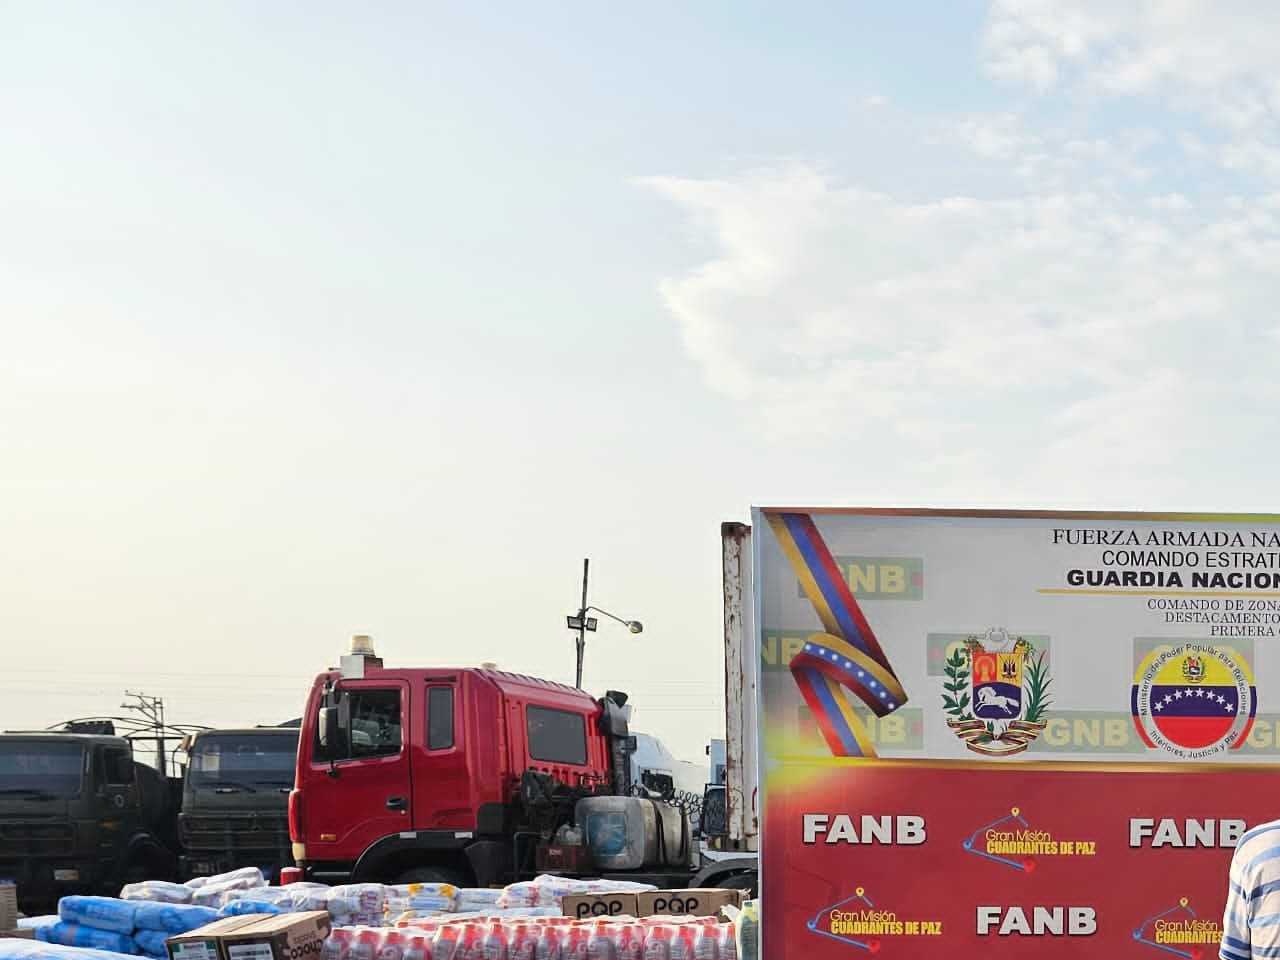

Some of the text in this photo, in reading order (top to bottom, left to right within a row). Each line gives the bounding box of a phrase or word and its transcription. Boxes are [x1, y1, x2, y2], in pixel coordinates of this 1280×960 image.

[1052, 529, 1142, 546] FUERZA
[1147, 531, 1245, 547] ARMADA
[1102, 550, 1199, 567] COMANDO
[838, 564, 905, 593] NB
[1067, 569, 1183, 588] GUARDIA
[1147, 599, 1220, 611] COMANDO
[1225, 599, 1244, 611] DE
[1165, 612, 1280, 624] DESTACAMENTO
[1211, 625, 1274, 637] PRIMERA
[761, 636, 804, 665] NB
[1160, 645, 1184, 663] Poder
[1186, 643, 1218, 656] Popular
[1043, 718, 1129, 747] GNB
[802, 814, 927, 845] FANB
[985, 829, 1051, 842] Gran Misión
[1129, 818, 1247, 849] FANB
[986, 841, 1096, 855] CUADRANTES DE PAZ
[830, 909, 896, 922] Gran Misión
[975, 906, 1097, 936] FANB
[830, 921, 942, 935] CUADRANTES DE PAZ
